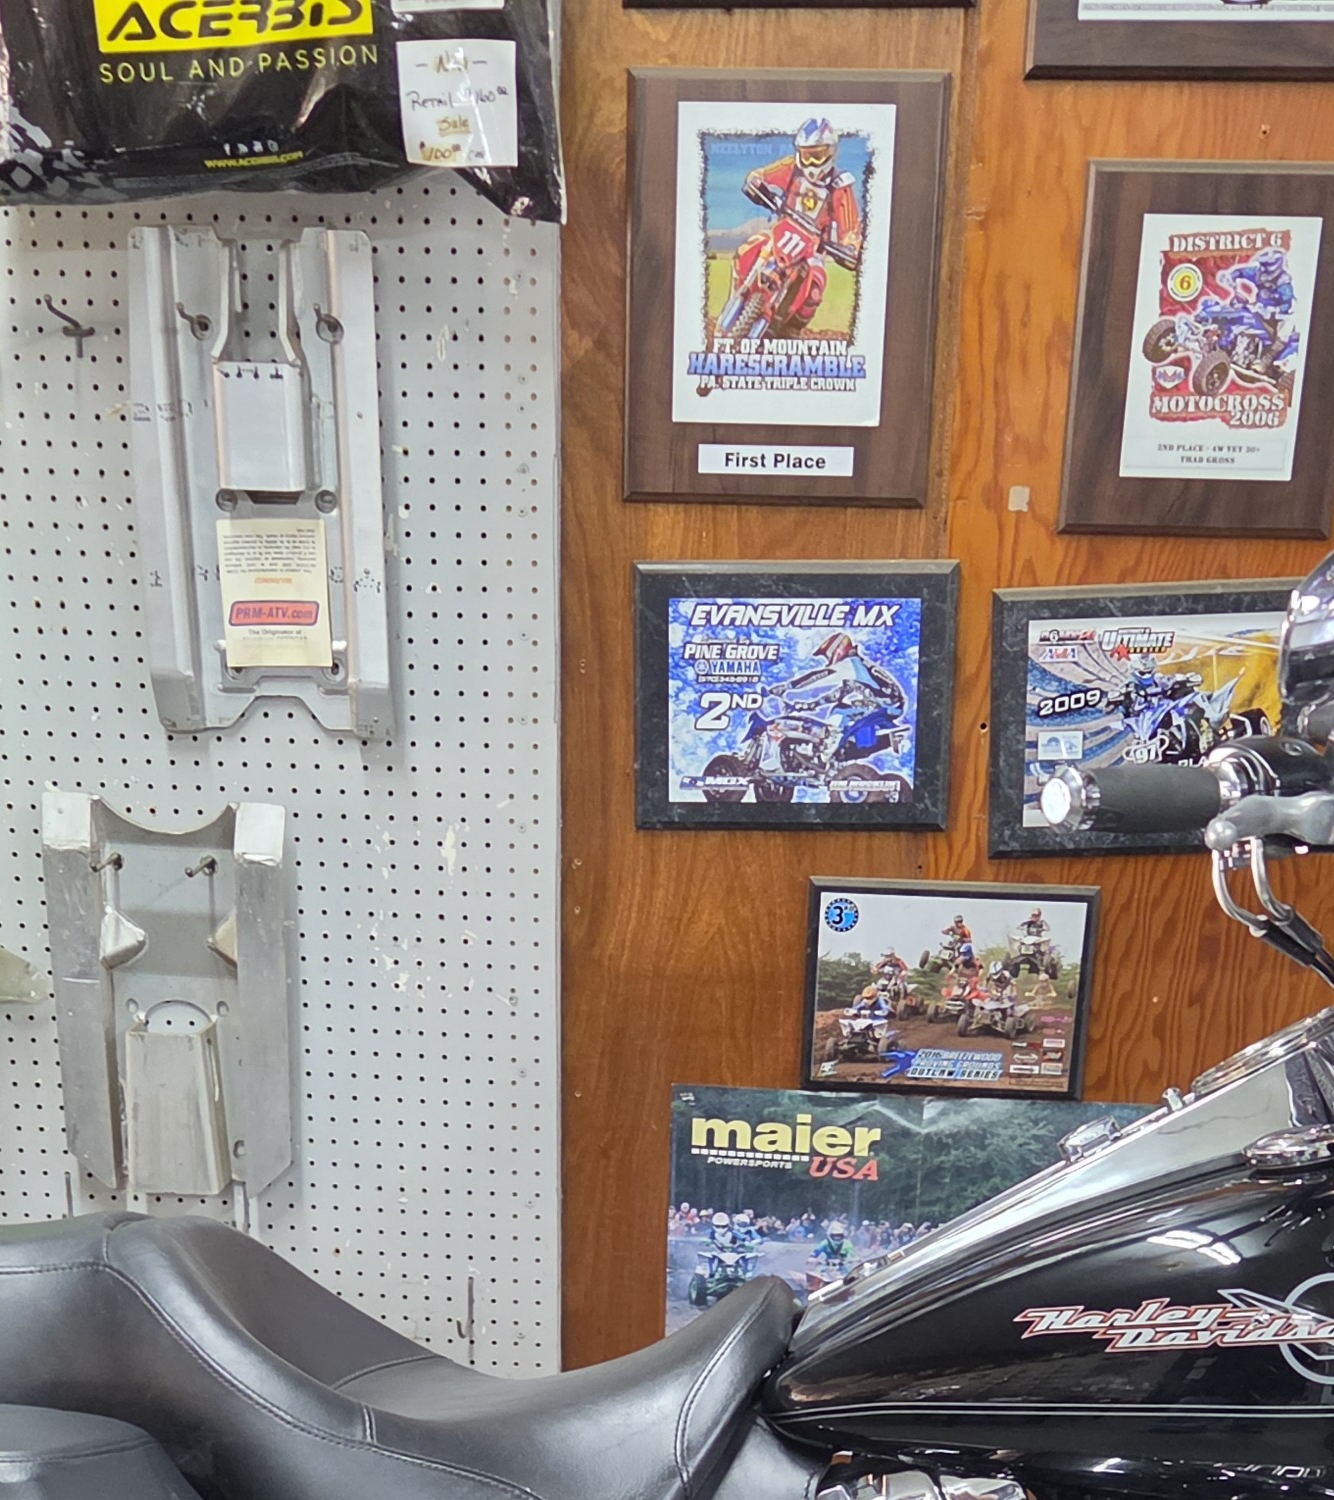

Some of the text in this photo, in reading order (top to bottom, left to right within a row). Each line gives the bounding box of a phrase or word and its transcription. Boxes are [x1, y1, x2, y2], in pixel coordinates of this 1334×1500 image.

[107, 0, 364, 41] ACERBIS
[99, 44, 380, 84] SOUL AND PASSION
[1173, 232, 1283, 252] DISTRICT 6
[1179, 275, 1192, 290] 6
[740, 338, 761, 354] OF
[764, 339, 848, 356] MOUNTAIN
[687, 352, 866, 378] HARESCRAMBLE
[722, 376, 763, 390] STATE
[766, 376, 807, 391] TRIPLE
[810, 377, 856, 391] CROWN
[1152, 394, 1285, 414] MOTOCROSS
[1230, 411, 1280, 426] 2006
[724, 452, 826, 469] First Place
[235, 606, 313, 620] PRM-ATV.com
[691, 604, 902, 627] EVANSVILLE MX
[1102, 629, 1174, 652] ULTIMATE
[684, 643, 780, 660] PINE GROVE
[710, 660, 762, 675] YAMAHA
[694, 692, 764, 731] 2ND
[1038, 689, 1102, 717] 2009
[691, 1113, 881, 1157] maier
[707, 1156, 792, 1169] POWERSPORTS
[809, 1156, 879, 1181] USA
